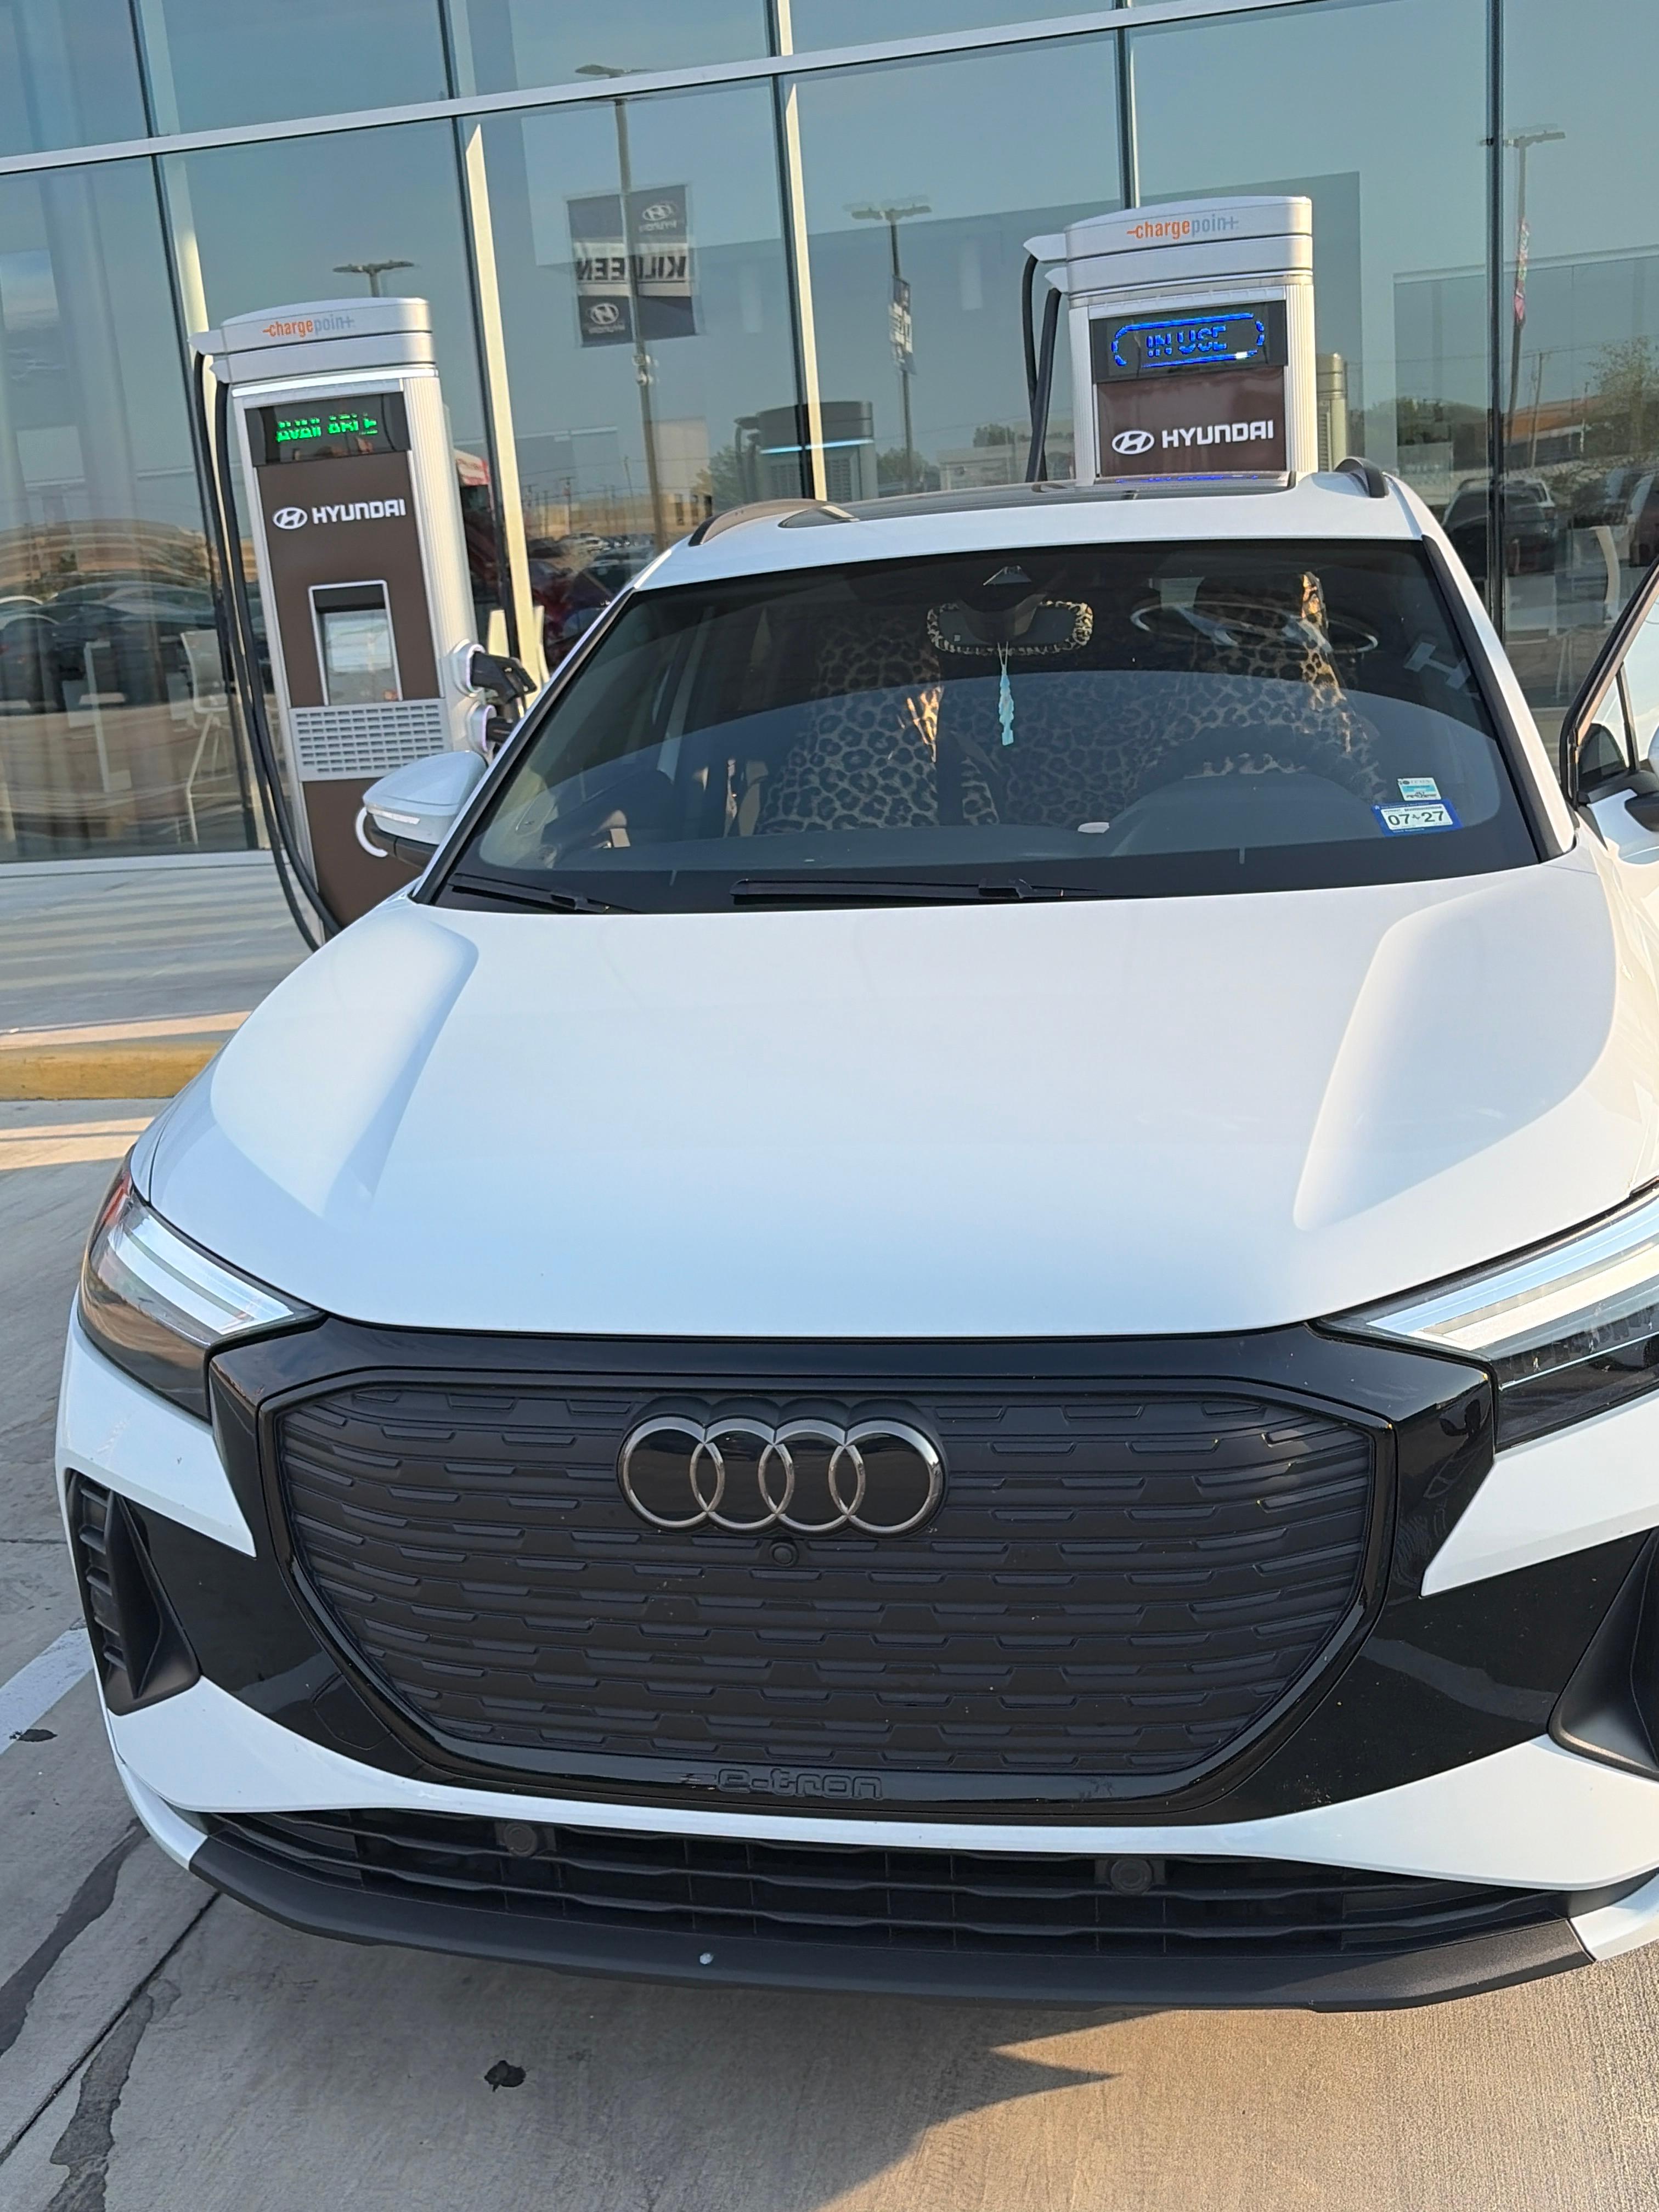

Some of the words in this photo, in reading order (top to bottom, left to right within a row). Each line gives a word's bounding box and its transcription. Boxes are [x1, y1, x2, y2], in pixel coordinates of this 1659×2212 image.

[1127, 214, 1239, 240] chargepoint
[263, 314, 354, 338] chargepoint
[1147, 332, 1172, 358] IN
[1177, 325, 1227, 355] USE
[1162, 420, 1273, 449] HYUNDAI
[312, 498, 406, 525] HYUNDAI
[1387, 814, 1410, 826] 07
[1421, 810, 1444, 822] 27
[718, 1768, 883, 1801] e-tron
